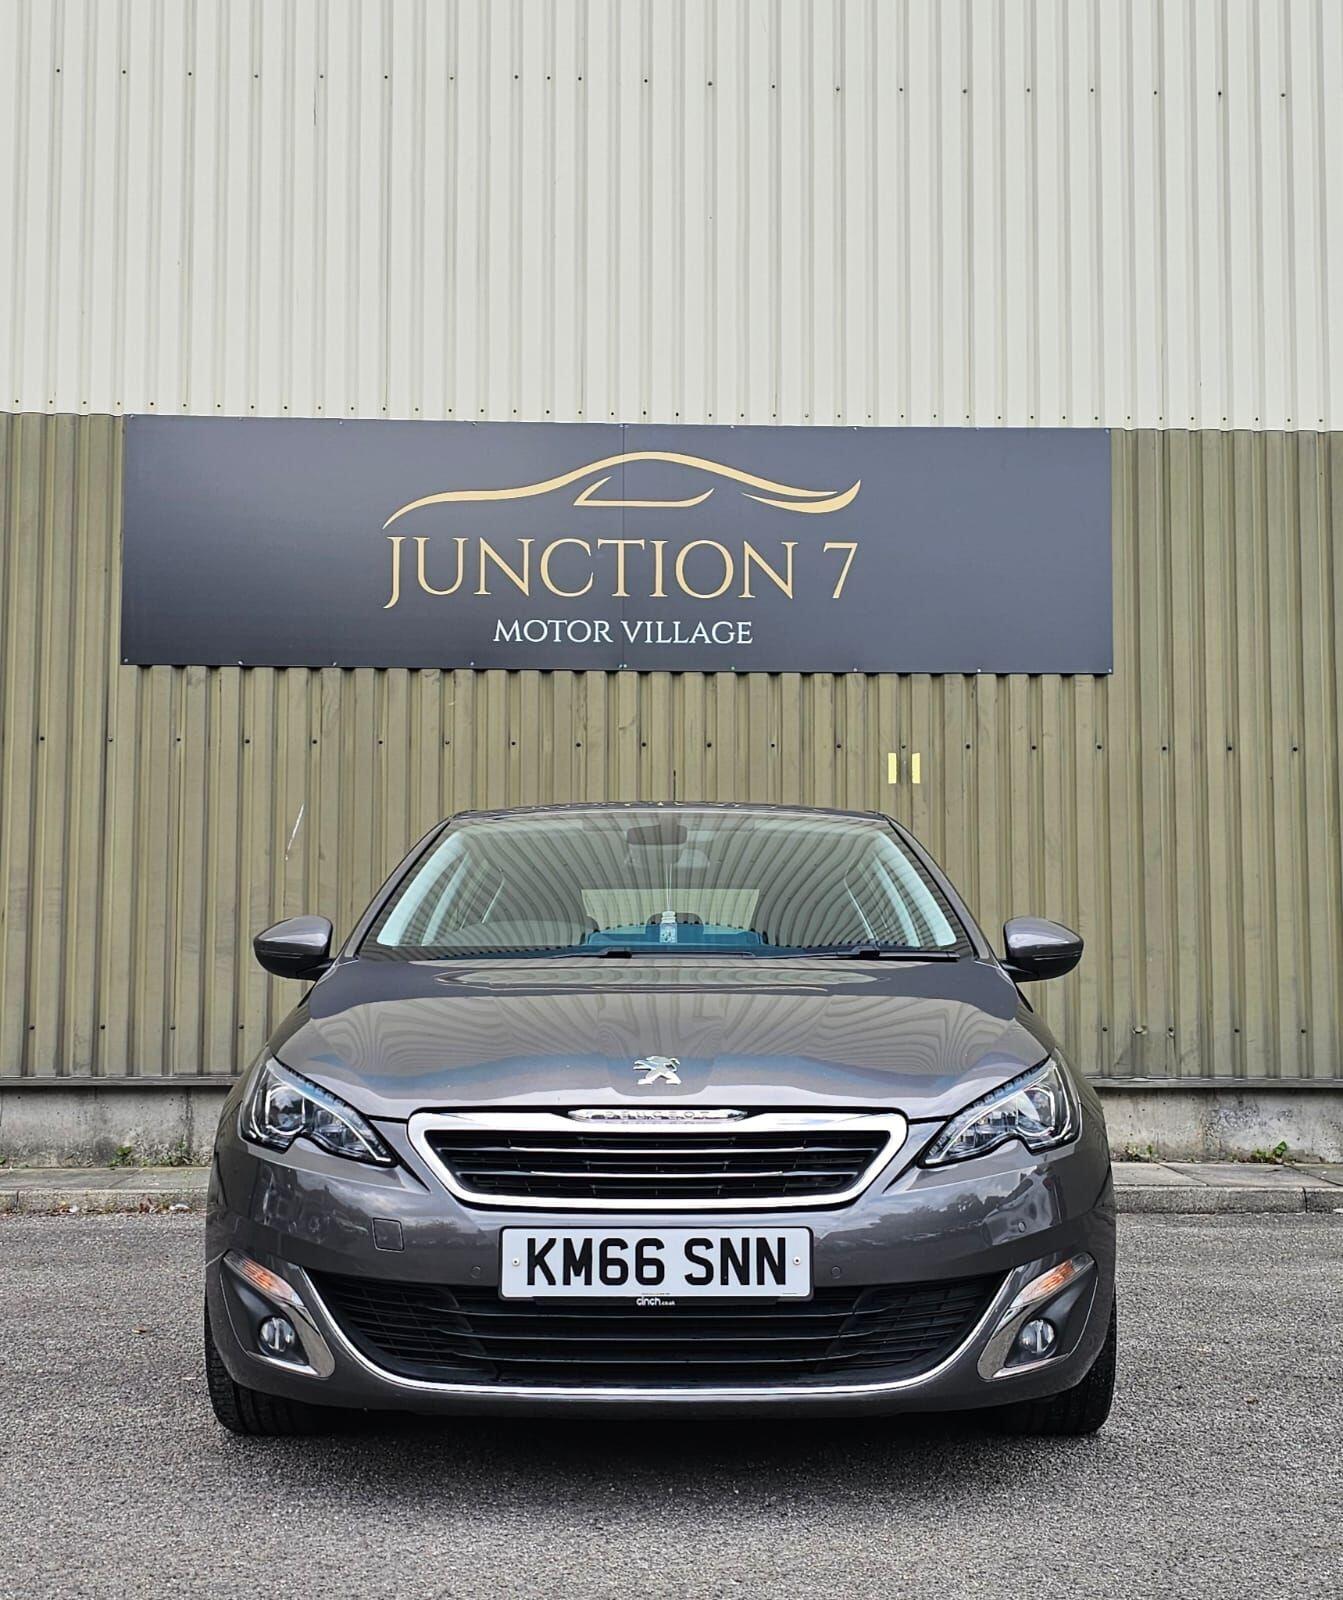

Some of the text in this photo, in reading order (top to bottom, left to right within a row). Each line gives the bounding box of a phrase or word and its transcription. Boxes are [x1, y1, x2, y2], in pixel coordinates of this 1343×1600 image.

[383, 535, 859, 609] JUNCTION 7
[493, 619, 754, 645] MOTOR VILLAGE
[526, 1237, 786, 1286] KM66 SNN
